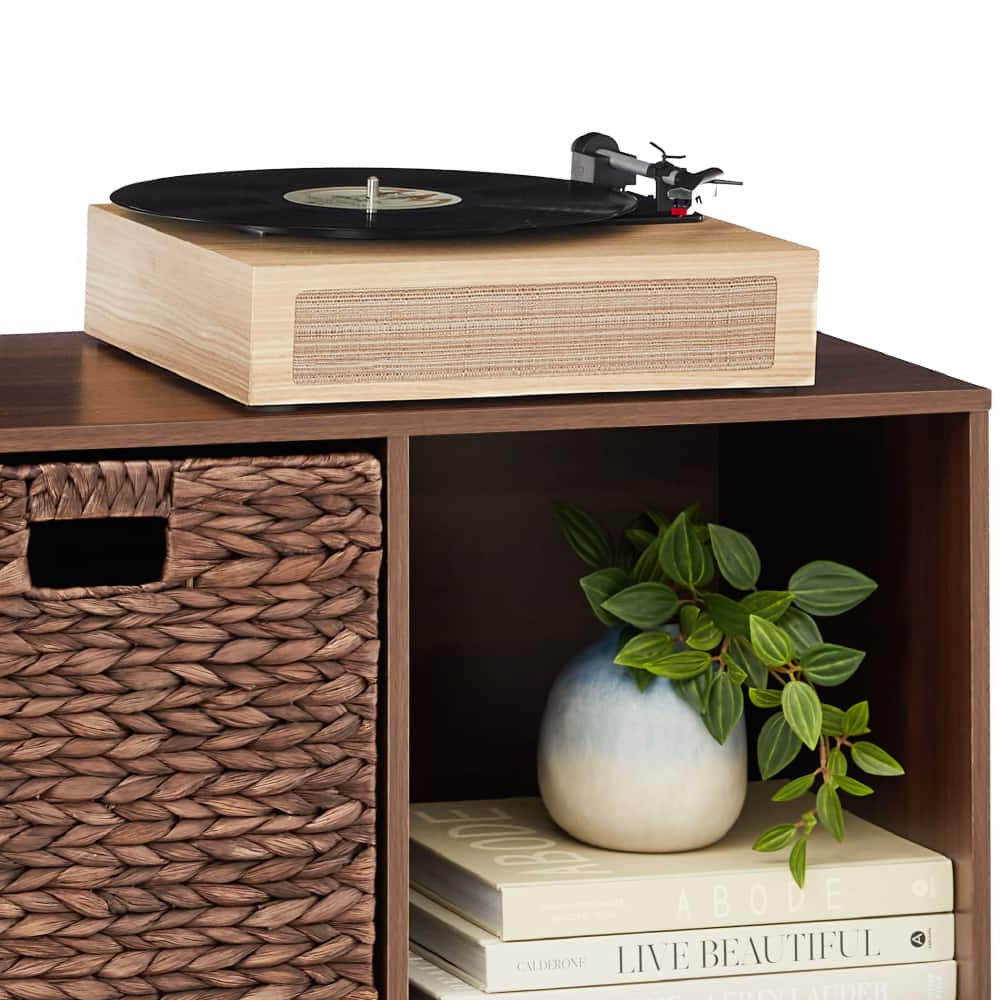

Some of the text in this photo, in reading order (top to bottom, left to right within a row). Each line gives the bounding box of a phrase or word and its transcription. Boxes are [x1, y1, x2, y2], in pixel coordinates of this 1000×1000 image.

[415, 808, 615, 875] ABODE
[675, 878, 842, 921] ABODE
[516, 957, 586, 973] CALDERONE
[616, 929, 881, 975] LIVE BEAUTIFUL
